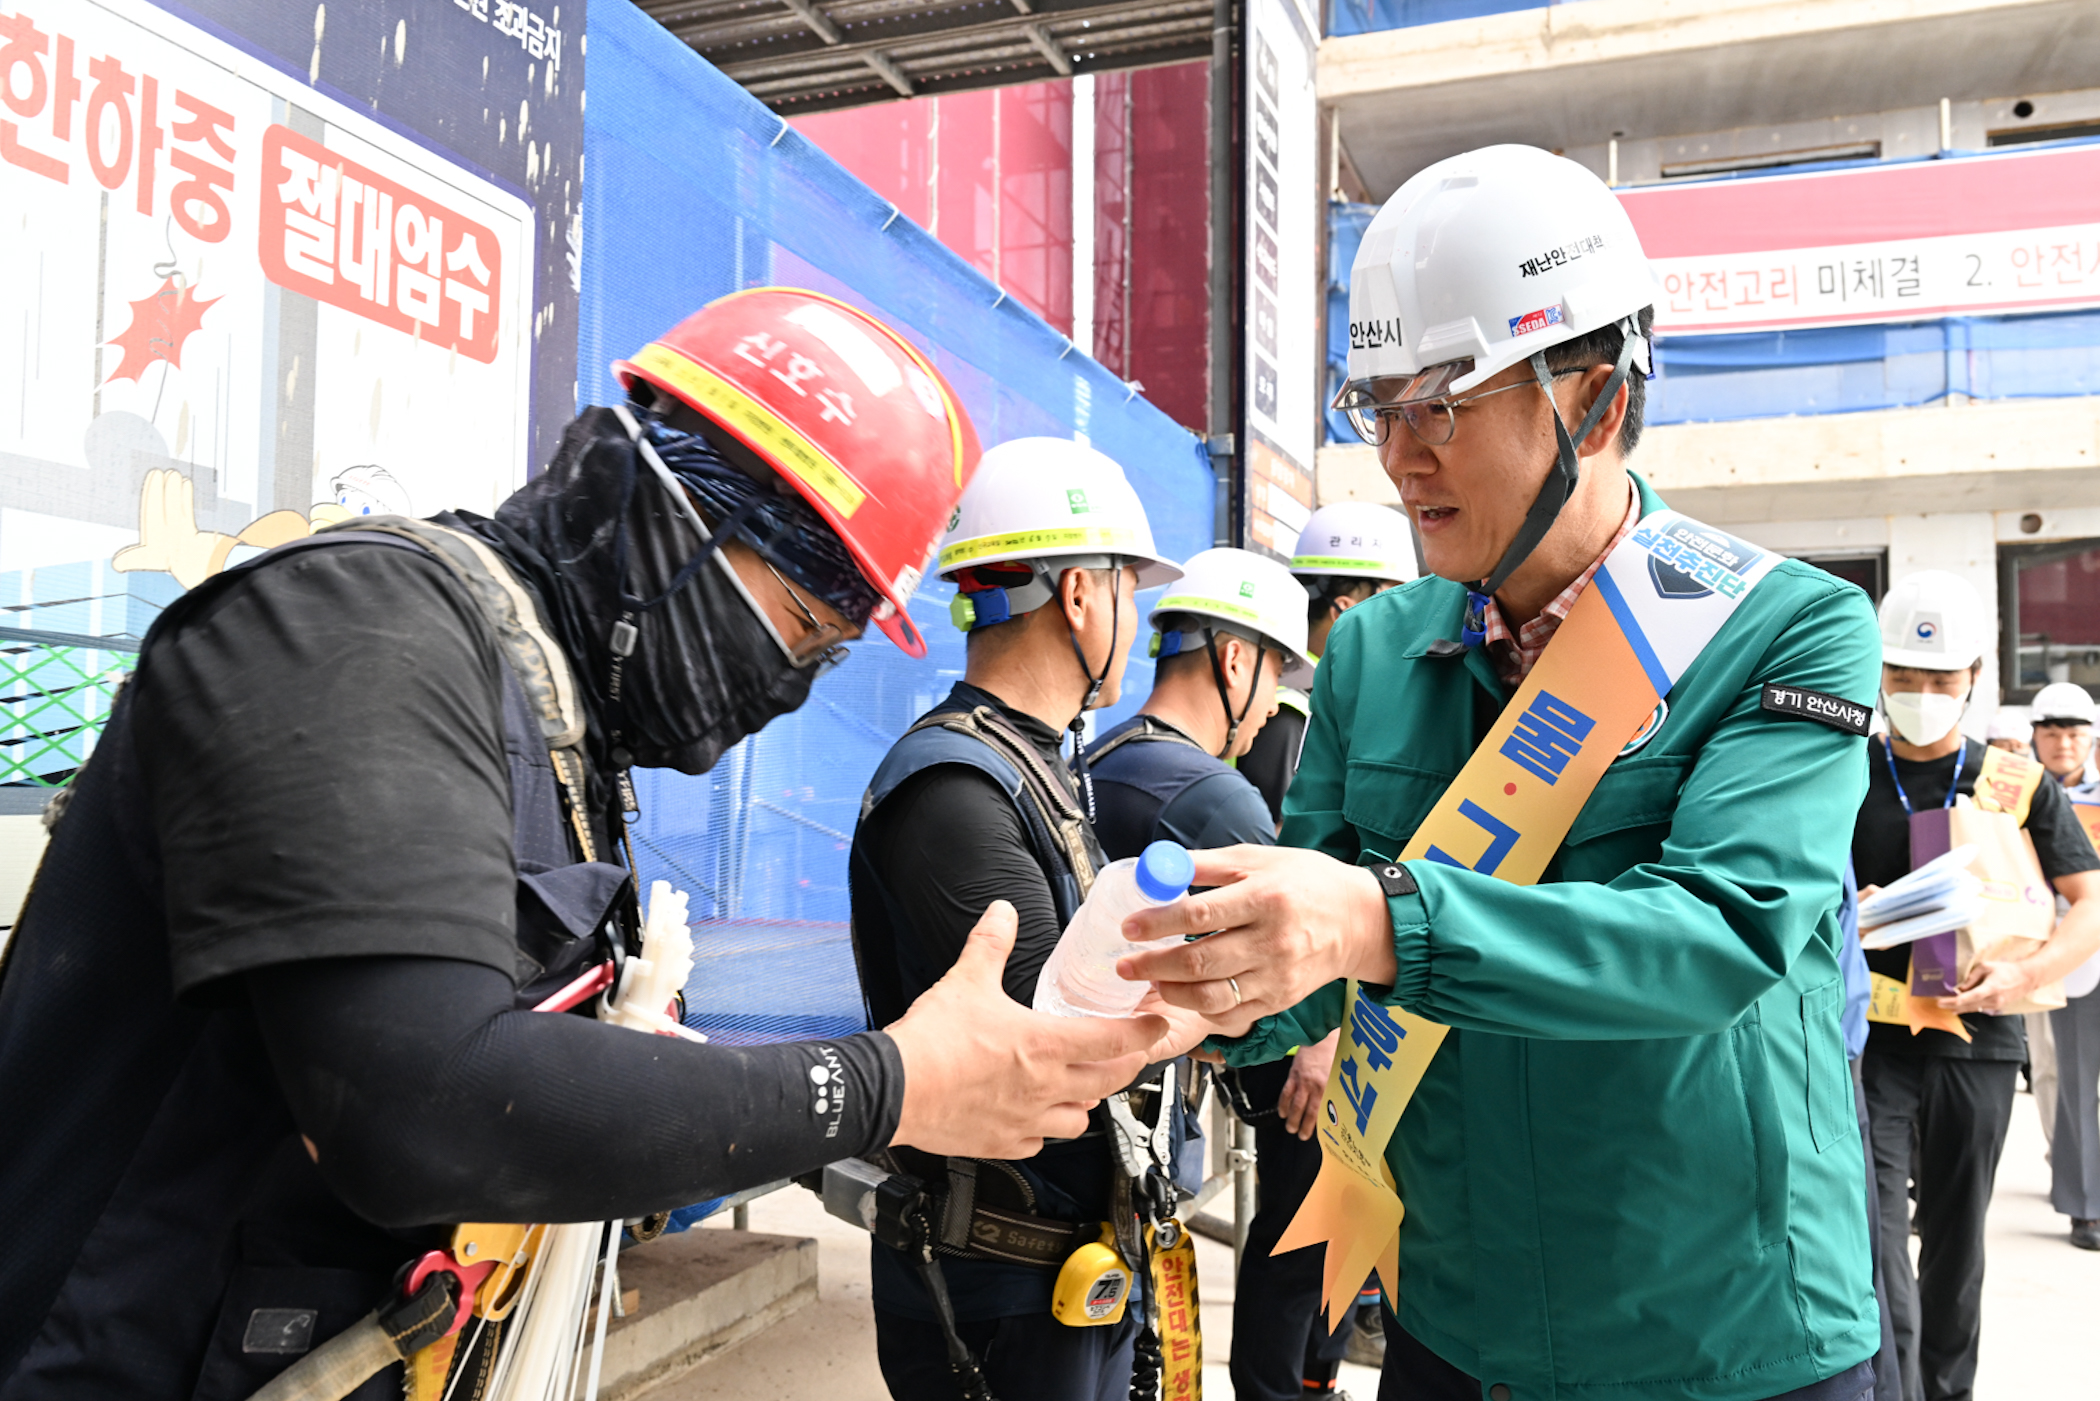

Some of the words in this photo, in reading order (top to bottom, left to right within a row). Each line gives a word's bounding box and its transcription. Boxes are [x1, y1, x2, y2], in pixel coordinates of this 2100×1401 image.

[278, 146, 491, 341] 절대엄수
[1664, 264, 1799, 313] 안전고리
[1817, 254, 1922, 302] 미체결
[1965, 253, 1993, 287] 2.
[1349, 318, 1402, 349] 안산시
[733, 331, 857, 426] 신호수
[1631, 527, 1747, 600] 실천추진단
[1673, 528, 1739, 567] 안전문화
[1769, 688, 1801, 708] 경기
[1806, 696, 1867, 727] 안산시청
[820, 1047, 846, 1138] BLUEANT
